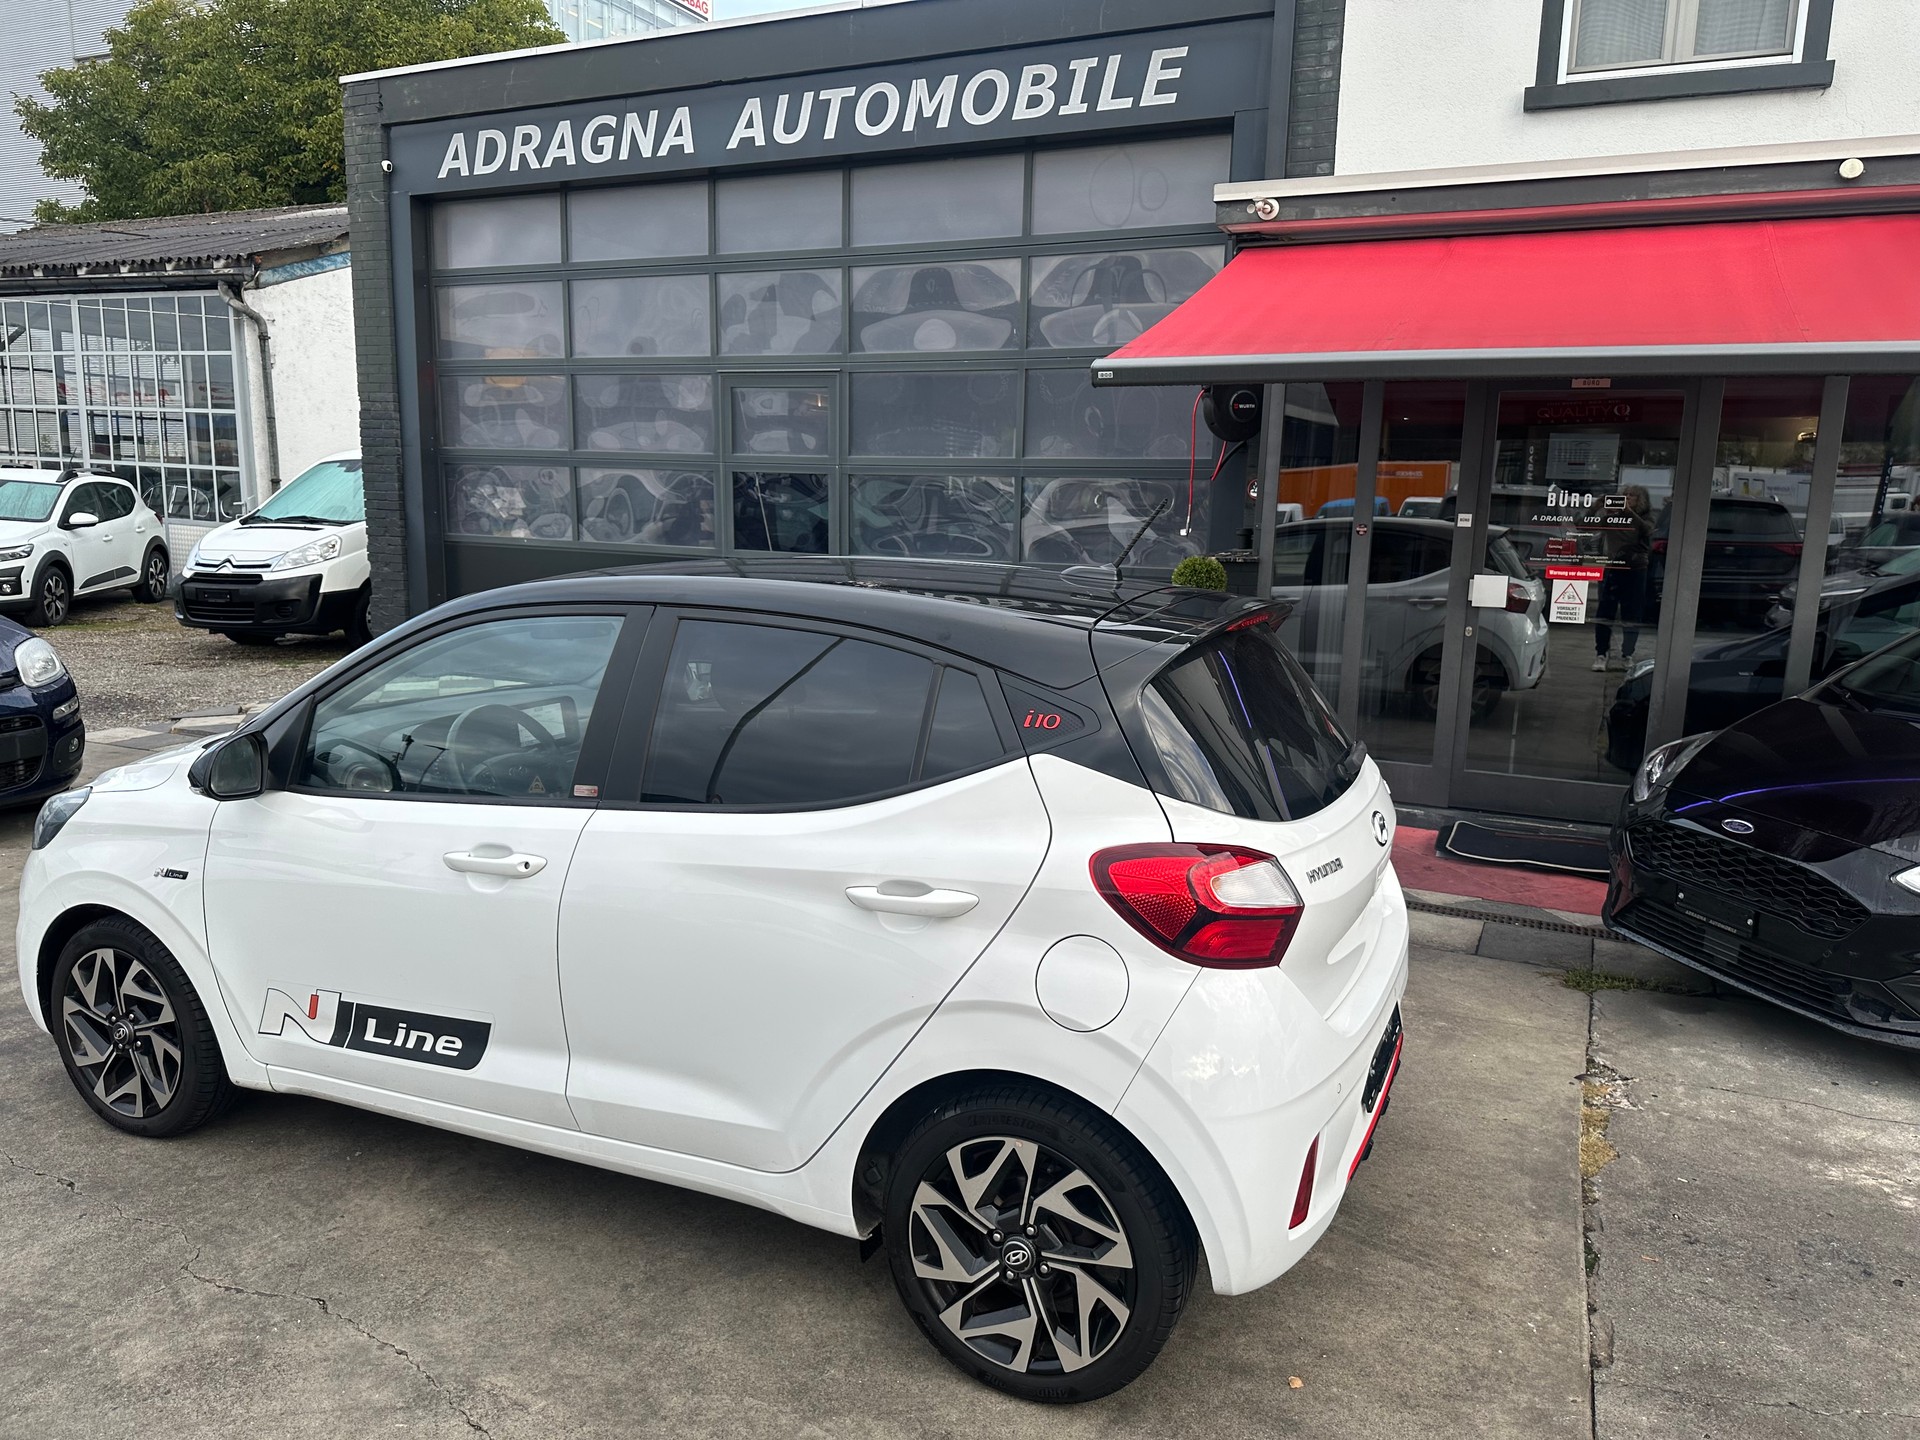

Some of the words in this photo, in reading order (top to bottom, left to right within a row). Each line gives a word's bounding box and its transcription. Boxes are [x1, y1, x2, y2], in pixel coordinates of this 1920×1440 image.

[437, 106, 695, 179] ADRAGNA
[726, 46, 1189, 150] AUTOMOBILE
[1547, 490, 1593, 507] BÜRO
[1023, 709, 1061, 729] i10
[364, 1018, 463, 1057] Line
